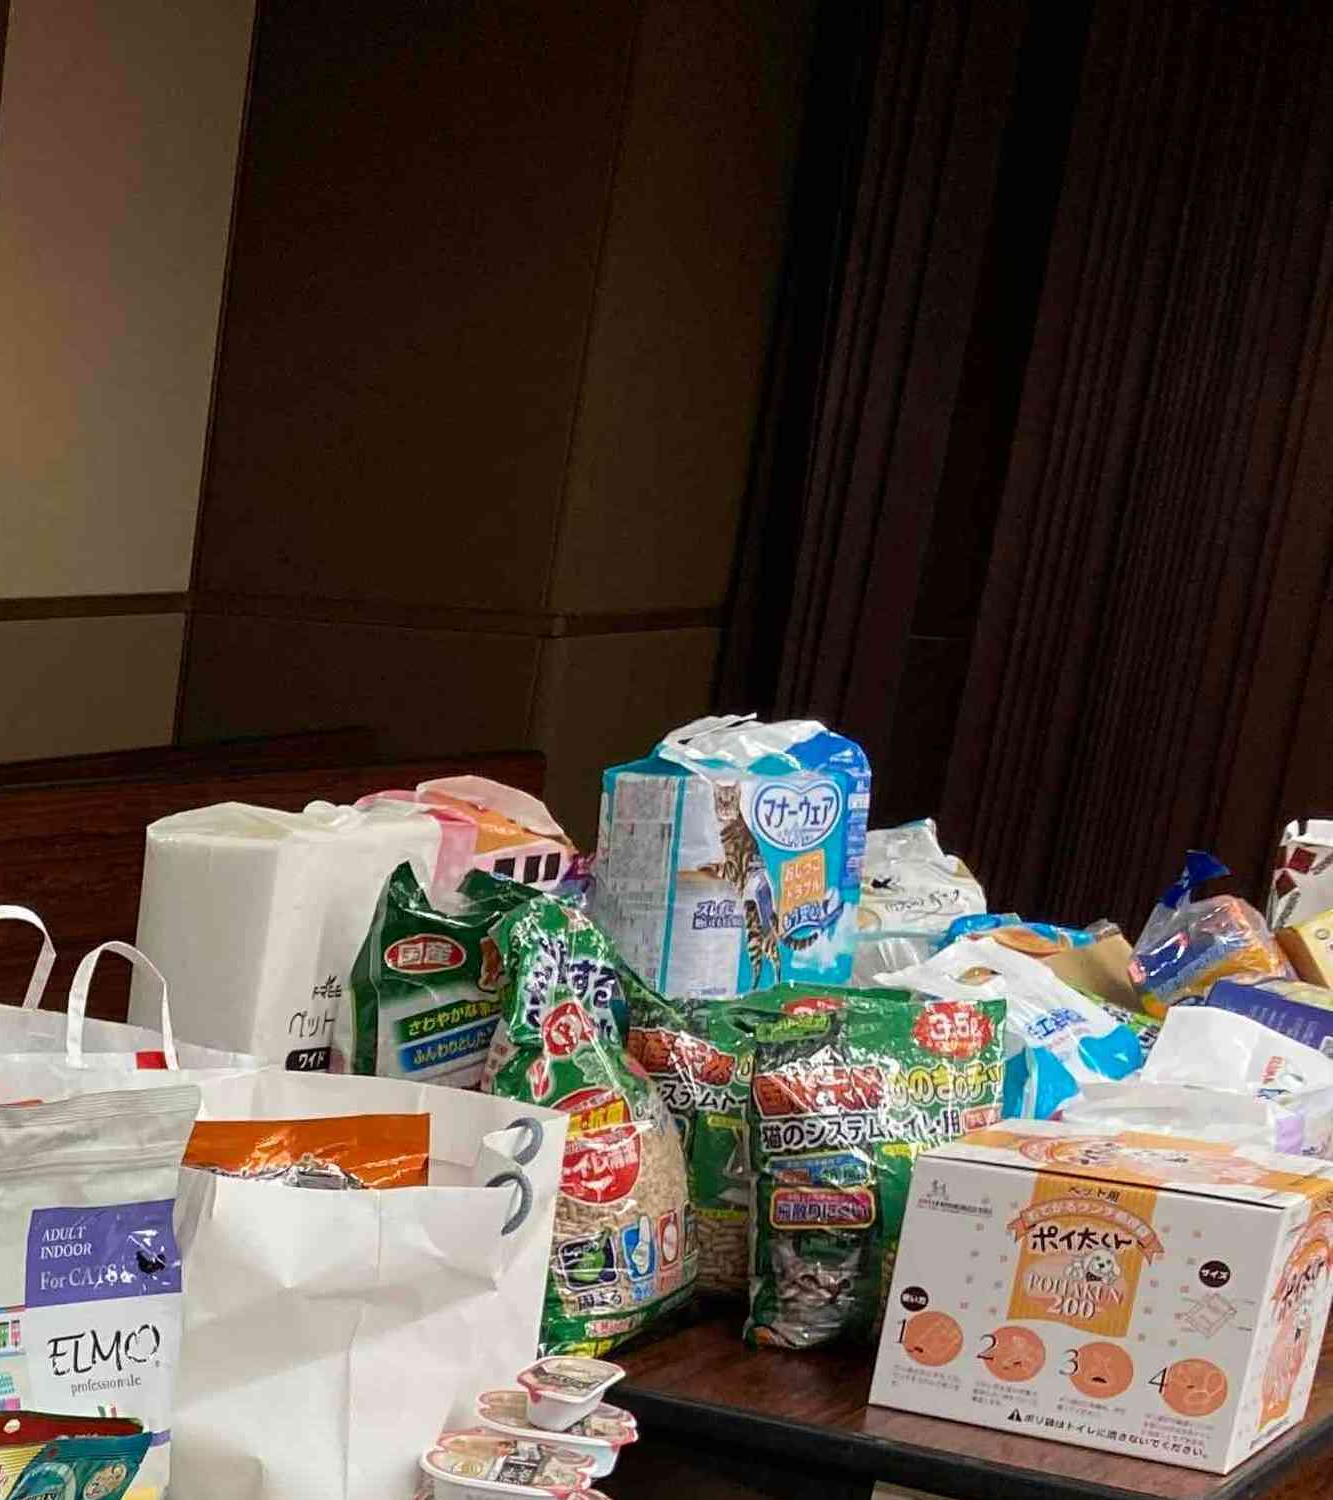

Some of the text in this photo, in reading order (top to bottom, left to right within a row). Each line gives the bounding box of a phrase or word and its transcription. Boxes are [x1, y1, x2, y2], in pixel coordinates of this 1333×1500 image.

[763, 795, 836, 829] マナーウェア
[41, 1224, 86, 1244] ADULT
[1032, 1226, 1135, 1253] ポイ太くん
[40, 1240, 94, 1261] INDOOR
[40, 1270, 67, 1291] For
[47, 1322, 162, 1380] ELMO
[977, 1332, 998, 1362] 2
[1059, 1348, 1080, 1377] 3
[1147, 1366, 1169, 1396] 4
